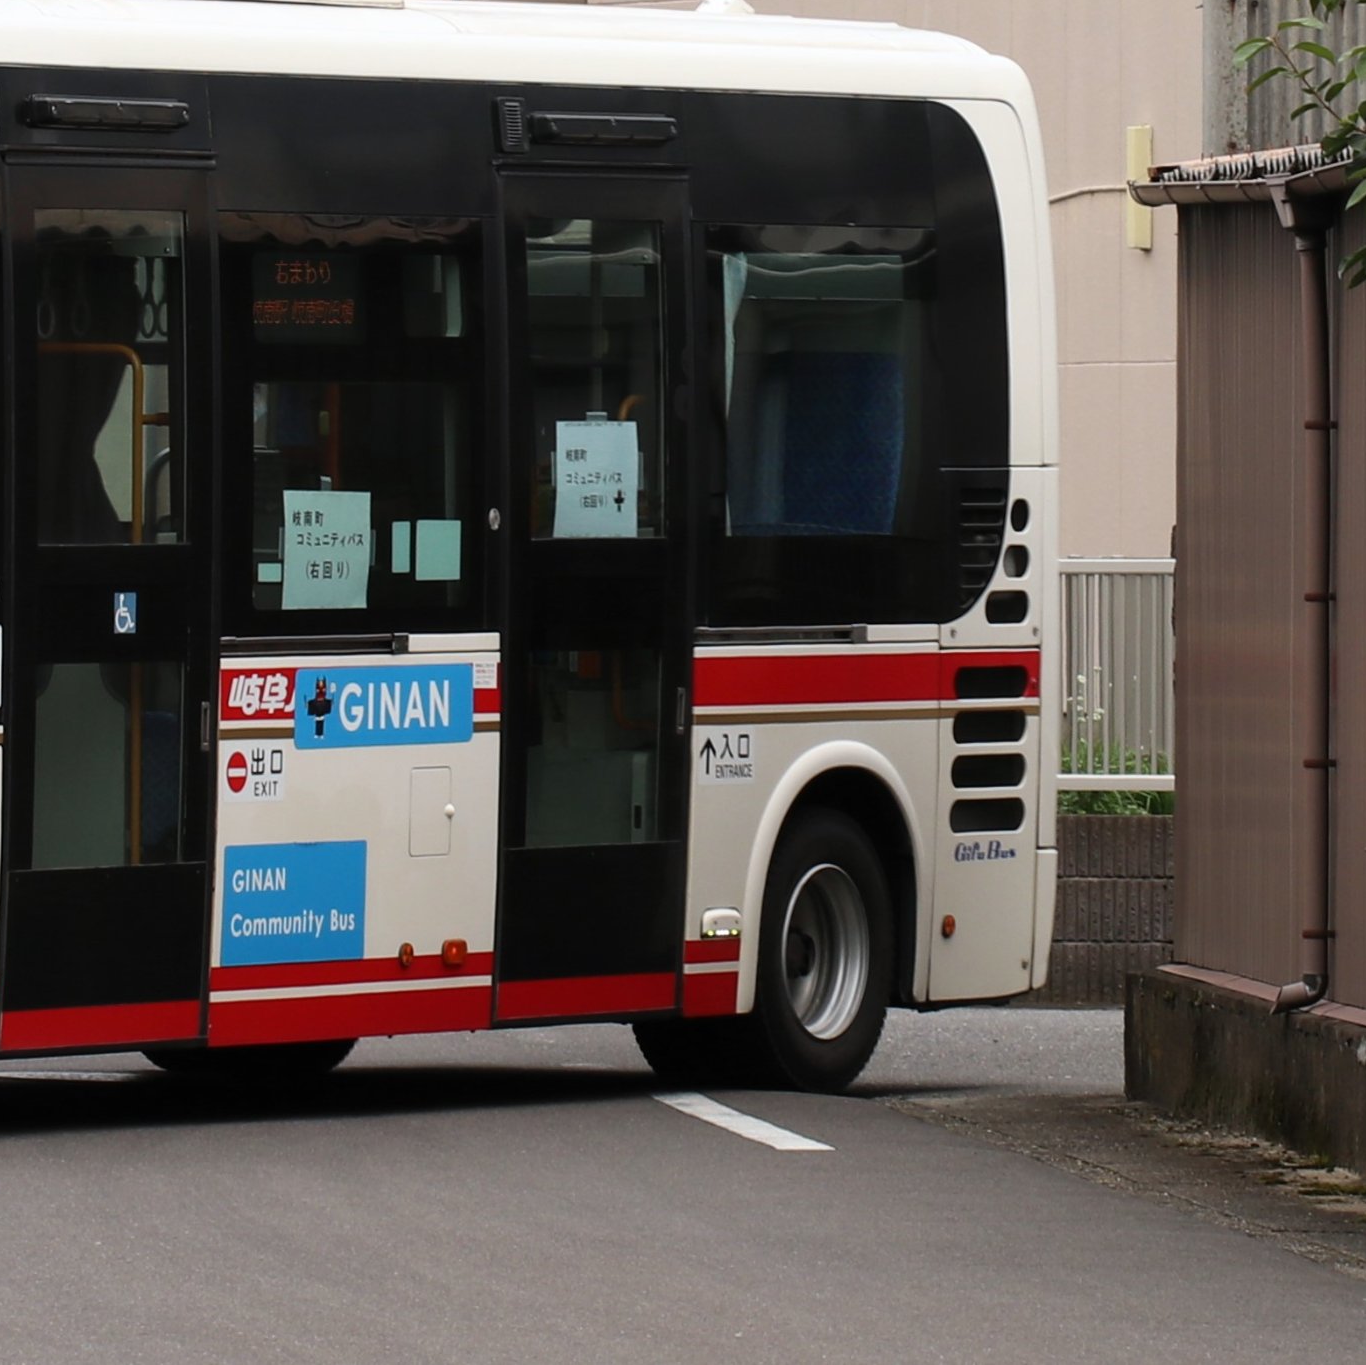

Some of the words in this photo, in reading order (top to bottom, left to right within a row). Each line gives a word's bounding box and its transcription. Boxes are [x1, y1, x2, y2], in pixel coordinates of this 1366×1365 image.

[275, 260, 331, 284] 右まわり
[565, 472, 623, 485] コミュニティバス
[292, 509, 324, 527] 岐南町
[296, 532, 365, 547] コミュニティバス
[228, 672, 296, 716] 岐阜
[338, 679, 451, 732] GINAN
[719, 733, 750, 759] 入口
[250, 747, 284, 776] 出口
[715, 764, 753, 779] ENTRANCE
[253, 780, 279, 797] EXIT
[954, 841, 985, 863] Gifu
[987, 839, 1017, 860] Bus
[232, 866, 287, 893] GINAN
[230, 909, 325, 939] Community
[329, 908, 356, 932] Bus
